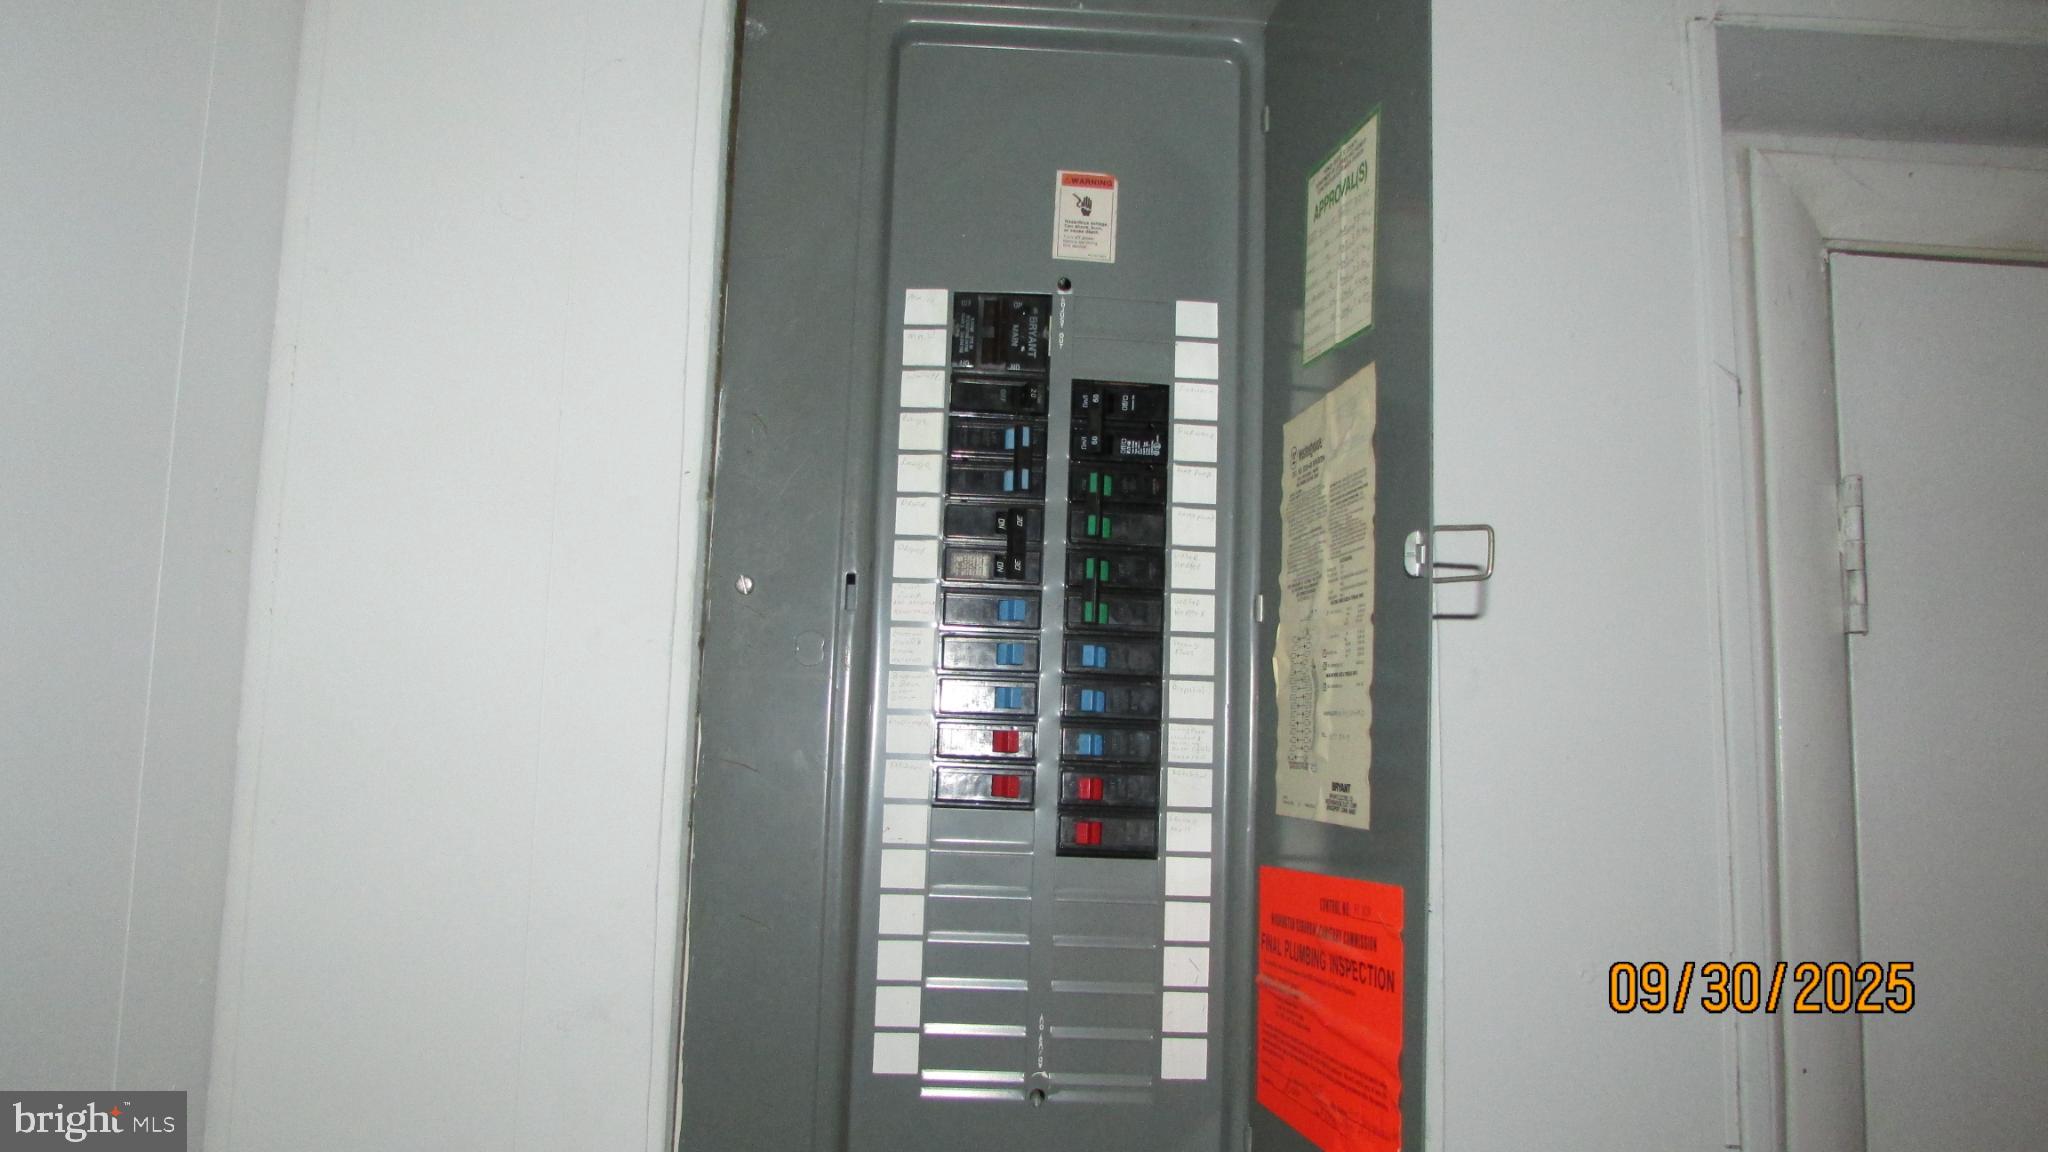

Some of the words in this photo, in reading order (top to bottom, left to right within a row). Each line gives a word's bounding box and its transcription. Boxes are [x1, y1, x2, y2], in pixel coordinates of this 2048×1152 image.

[1071, 177, 1113, 188] WARNING
[1313, 159, 1368, 223] APPROVAL(S)
[1011, 324, 1020, 348] MAIN
[1027, 315, 1039, 359] BRYANT
[1030, 387, 1036, 398] 20
[1092, 393, 1100, 403] 60
[1091, 435, 1099, 445] 60
[997, 518, 1006, 530] ON
[997, 561, 1004, 573] ON
[1014, 558, 1022, 571] 30
[1331, 781, 1351, 793] BRYANT
[1261, 931, 1281, 956] FINAL
[1284, 939, 1326, 971] PLUMBING
[1328, 953, 1395, 993] INSPECTION
